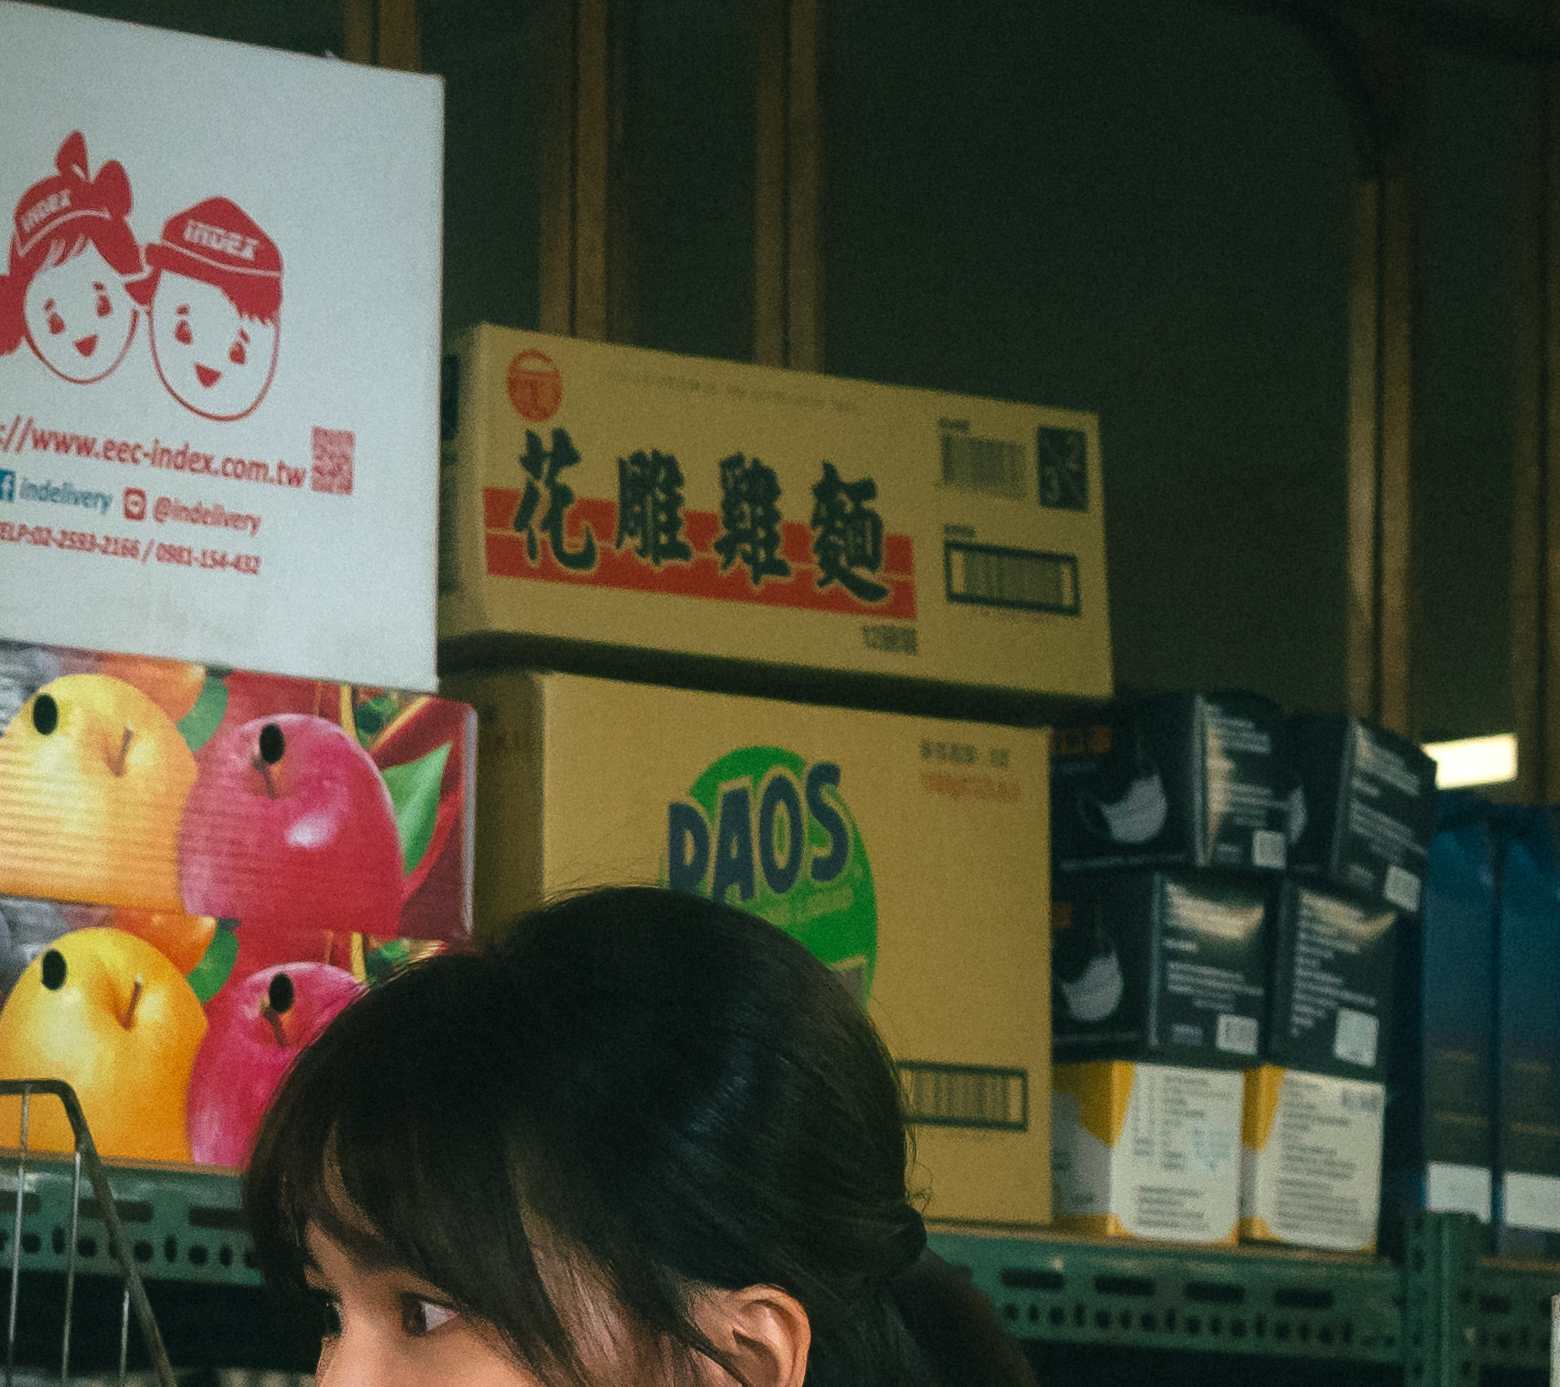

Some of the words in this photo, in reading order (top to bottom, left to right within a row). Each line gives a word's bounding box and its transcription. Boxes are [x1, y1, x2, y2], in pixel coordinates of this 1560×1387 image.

[20, 477, 113, 515] indelivery
[513, 427, 893, 603] 花雕雞麵
